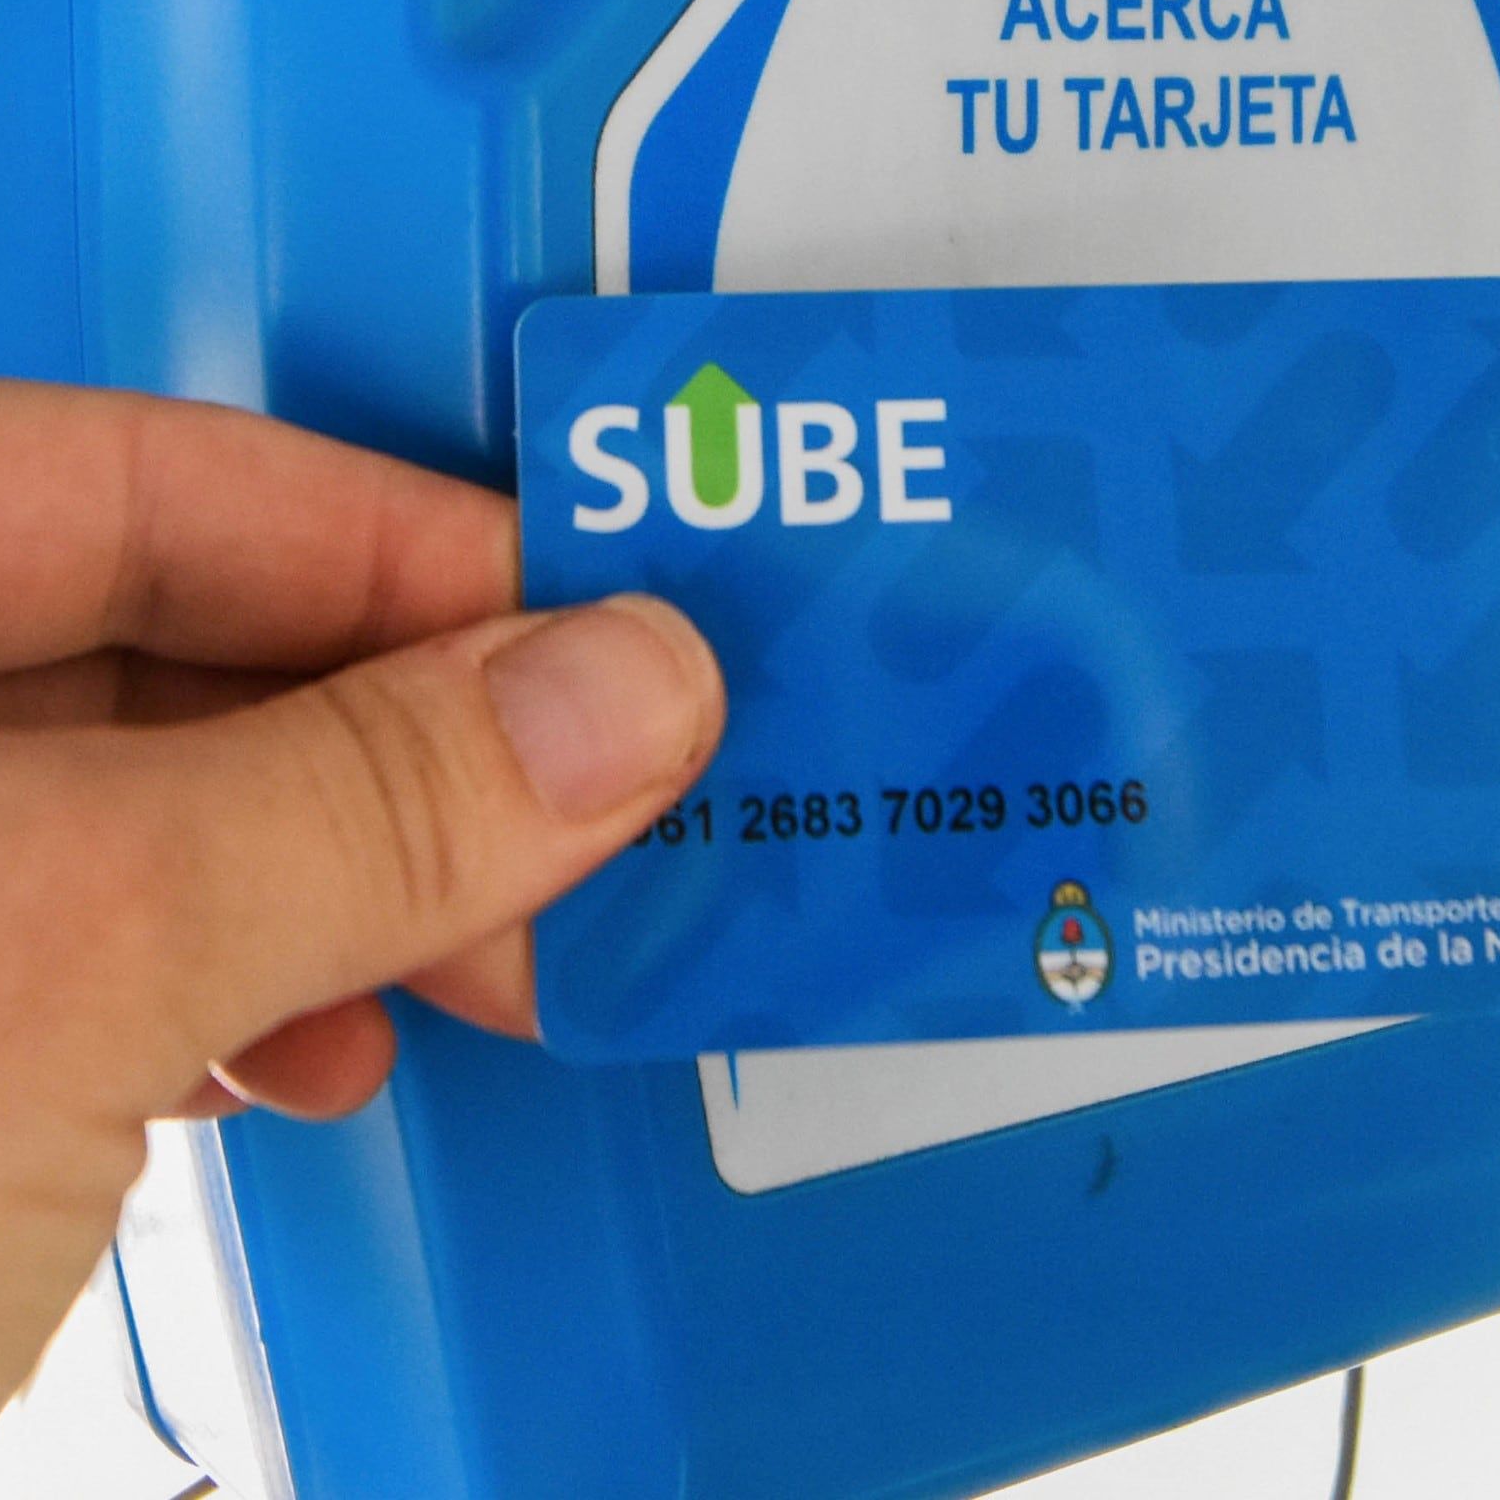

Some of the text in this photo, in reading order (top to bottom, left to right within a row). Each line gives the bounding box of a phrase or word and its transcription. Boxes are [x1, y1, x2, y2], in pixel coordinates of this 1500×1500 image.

[945, 73, 1358, 156] TU TARJETA
[567, 397, 953, 534] SUBE
[740, 790, 863, 842] 2683
[880, 784, 1007, 836] 7029
[1026, 778, 1149, 830] 3066
[1133, 901, 1286, 939] Ministerio
[1292, 898, 1333, 932] de
[1136, 933, 1367, 982] Presidencia
[1377, 930, 1428, 970] de
[1438, 928, 1474, 967] la
